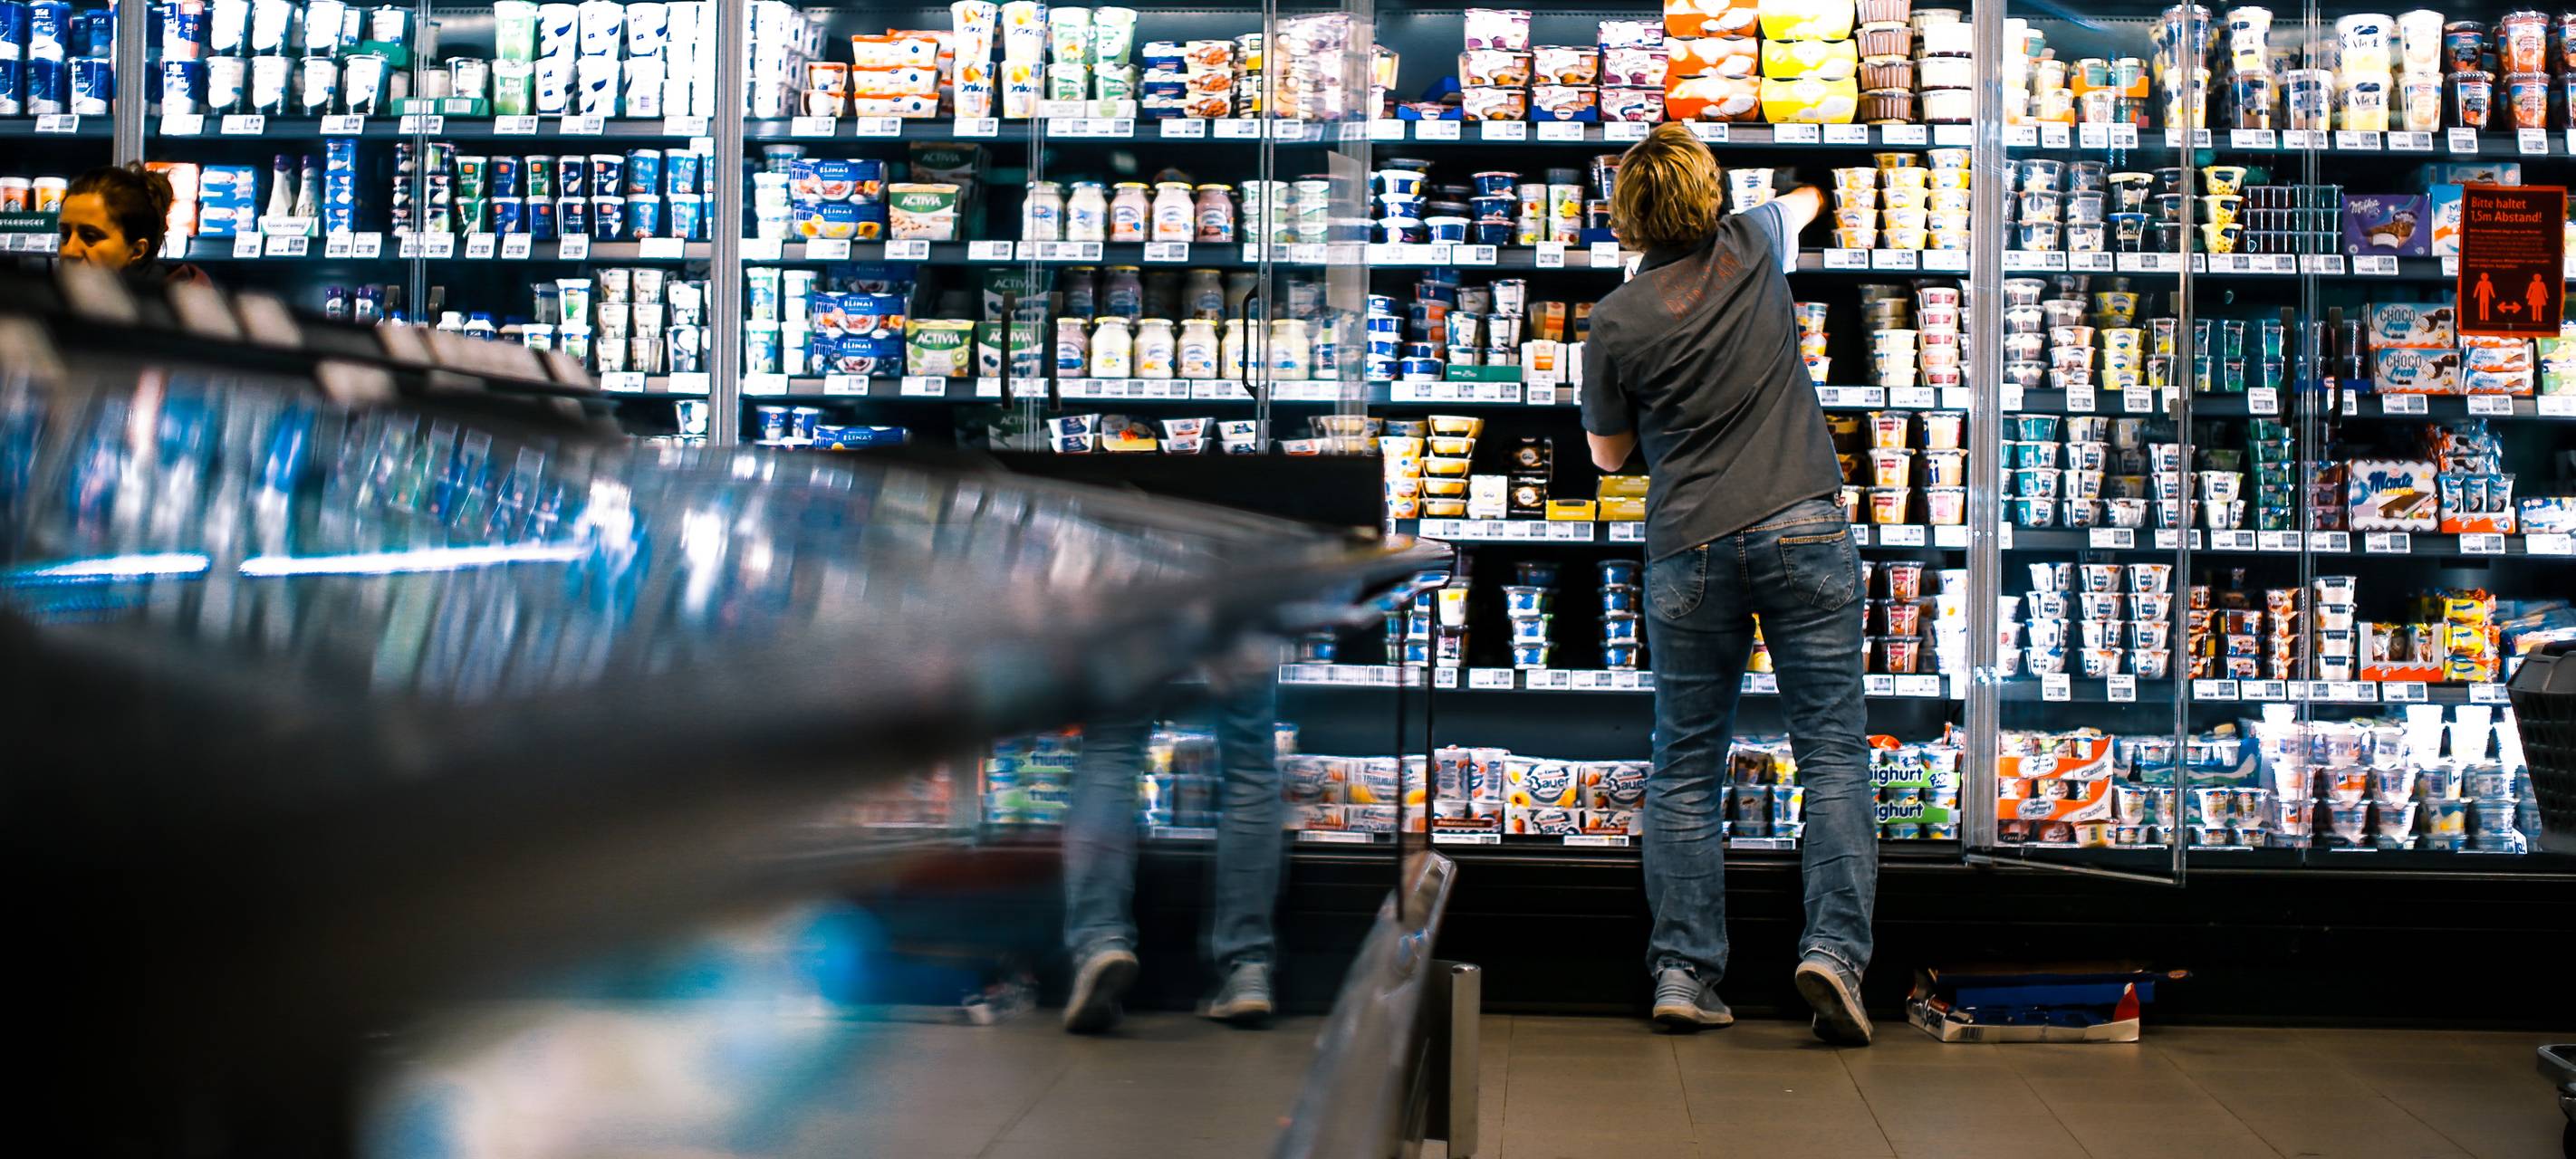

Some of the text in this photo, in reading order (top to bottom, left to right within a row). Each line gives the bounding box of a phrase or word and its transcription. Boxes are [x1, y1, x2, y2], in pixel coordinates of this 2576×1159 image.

[900, 194, 942, 206] ACTIVIA
[2350, 198, 2380, 214] Milka
[2471, 197, 2526, 209] Bitte haltet
[2471, 210, 2542, 223] 1,5m Abstand!
[2380, 310, 2415, 321] CHOCO
[2384, 321, 2411, 332] fresh
[916, 331, 961, 344] ACTIVIA
[988, 330, 1032, 342] ACIVIA
[2387, 355, 2422, 368] CHOCO
[2390, 367, 2417, 378] fresh
[843, 434, 873, 442] ELINAS
[2369, 472, 2413, 493] Monte
[2081, 761, 2107, 778] Classic
[1525, 775, 1571, 791] Bauer
[1605, 776, 1648, 793] Bauer
[2080, 804, 2105, 819] Classic
